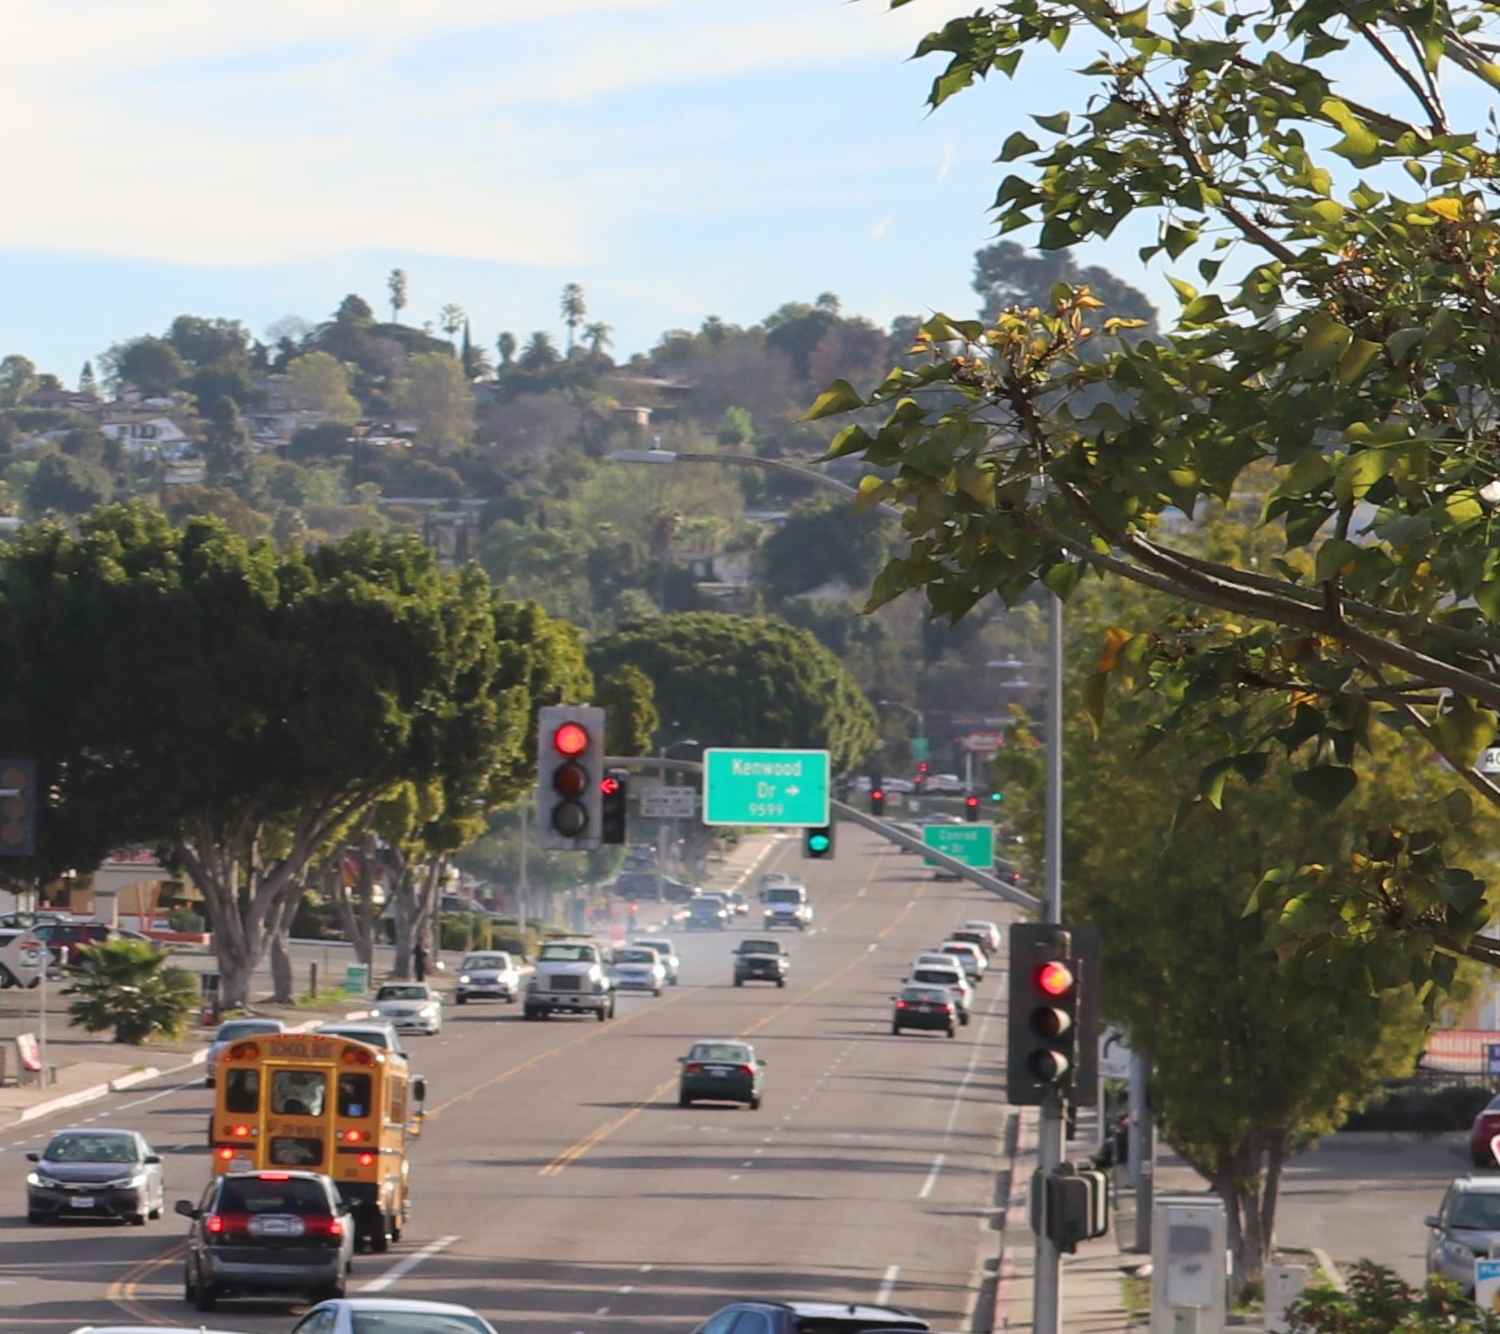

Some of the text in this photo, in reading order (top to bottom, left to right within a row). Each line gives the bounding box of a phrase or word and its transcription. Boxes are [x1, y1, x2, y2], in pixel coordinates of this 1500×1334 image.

[732, 759, 802, 776] Kenwood
[757, 782, 776, 798] Dr
[269, 1041, 333, 1060] SCHOOL BUS
